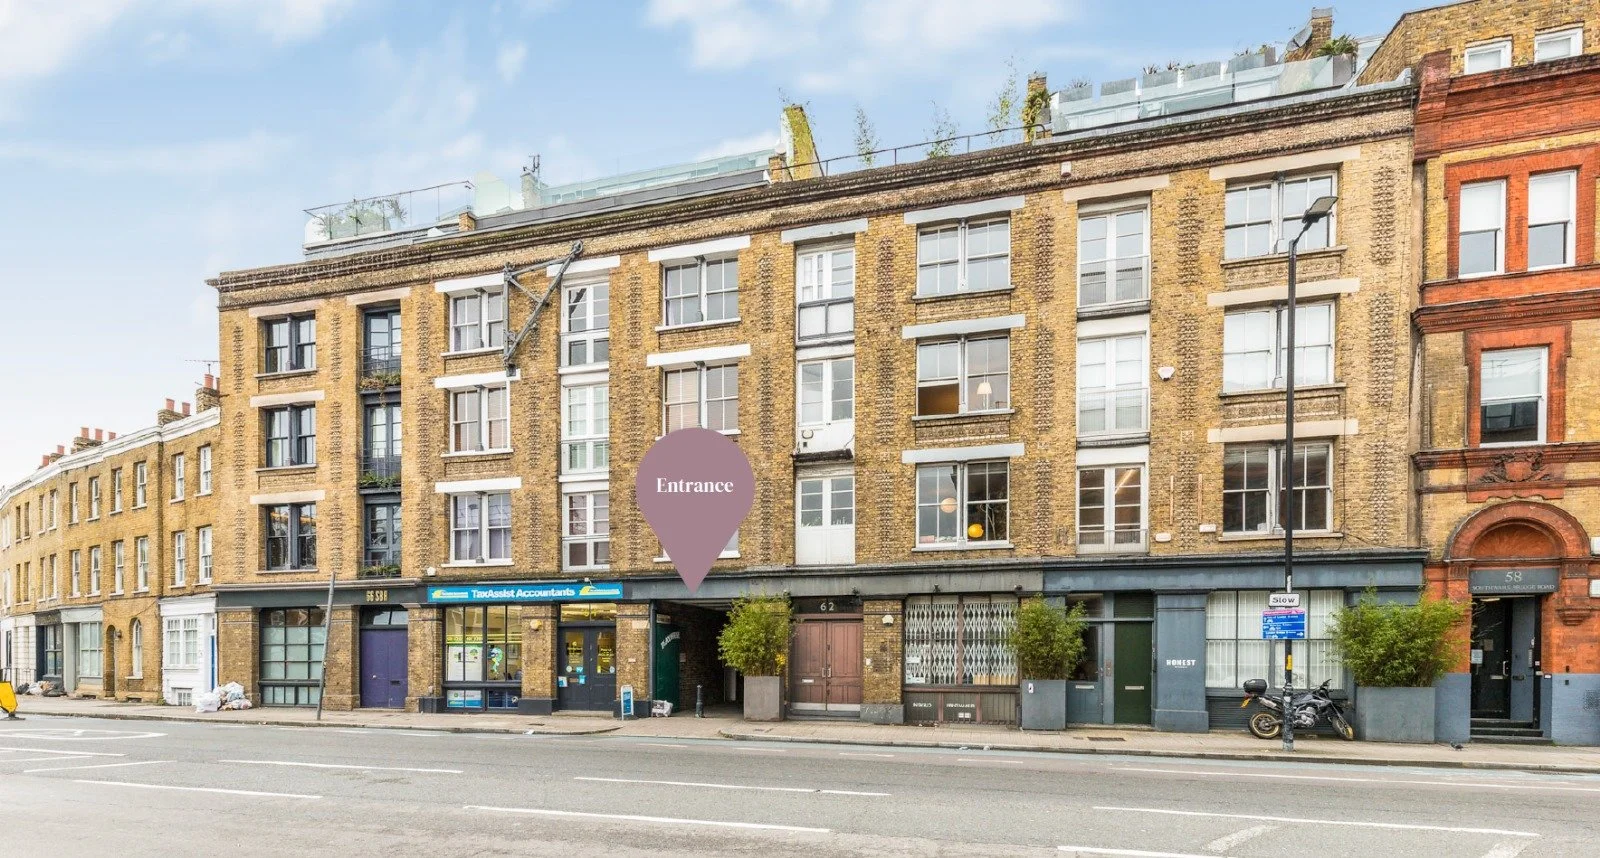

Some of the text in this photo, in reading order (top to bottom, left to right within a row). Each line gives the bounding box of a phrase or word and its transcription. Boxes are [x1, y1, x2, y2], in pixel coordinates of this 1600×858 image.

[1504, 571, 1522, 583] 58
[471, 588, 515, 599] TaxAssist
[515, 587, 576, 598] Accountants
[820, 602, 835, 611] 62
